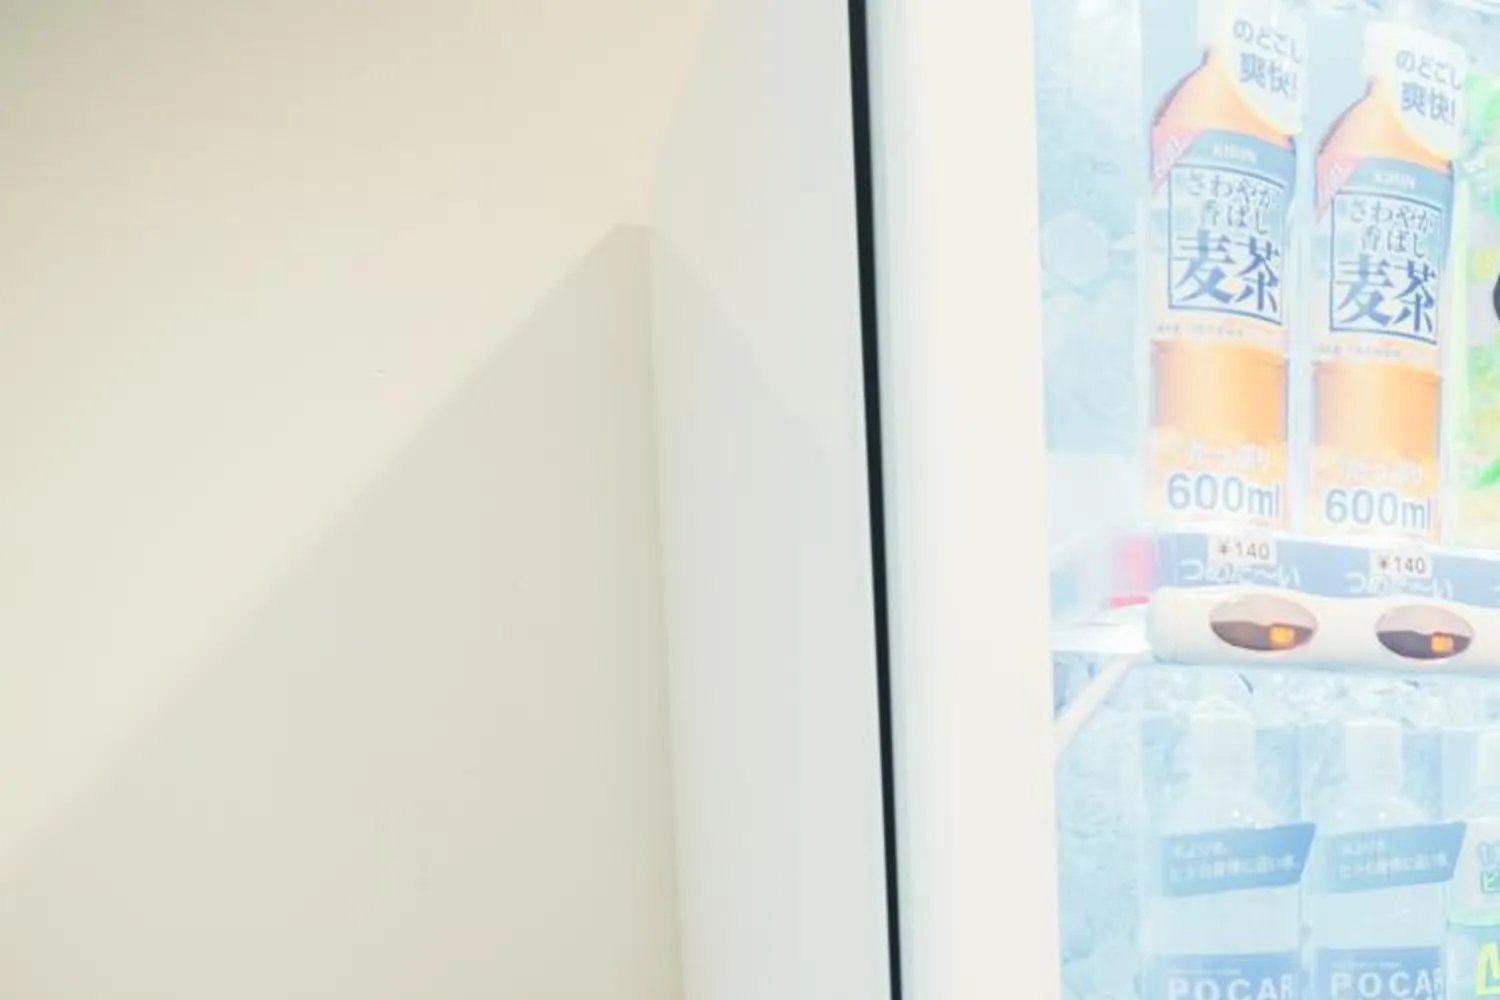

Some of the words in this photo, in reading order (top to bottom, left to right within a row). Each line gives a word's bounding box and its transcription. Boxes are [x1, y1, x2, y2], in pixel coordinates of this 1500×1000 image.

[1232, 17, 1303, 64] のどこし
[1396, 49, 1463, 91] のどこし
[1174, 228, 1281, 313] 麦茶
[1335, 253, 1437, 334] 麦茶
[1166, 470, 1281, 519] 600ml
[1323, 486, 1432, 531] 600ml
[1217, 540, 1270, 561] ¥140
[1377, 555, 1427, 575] ¥140
